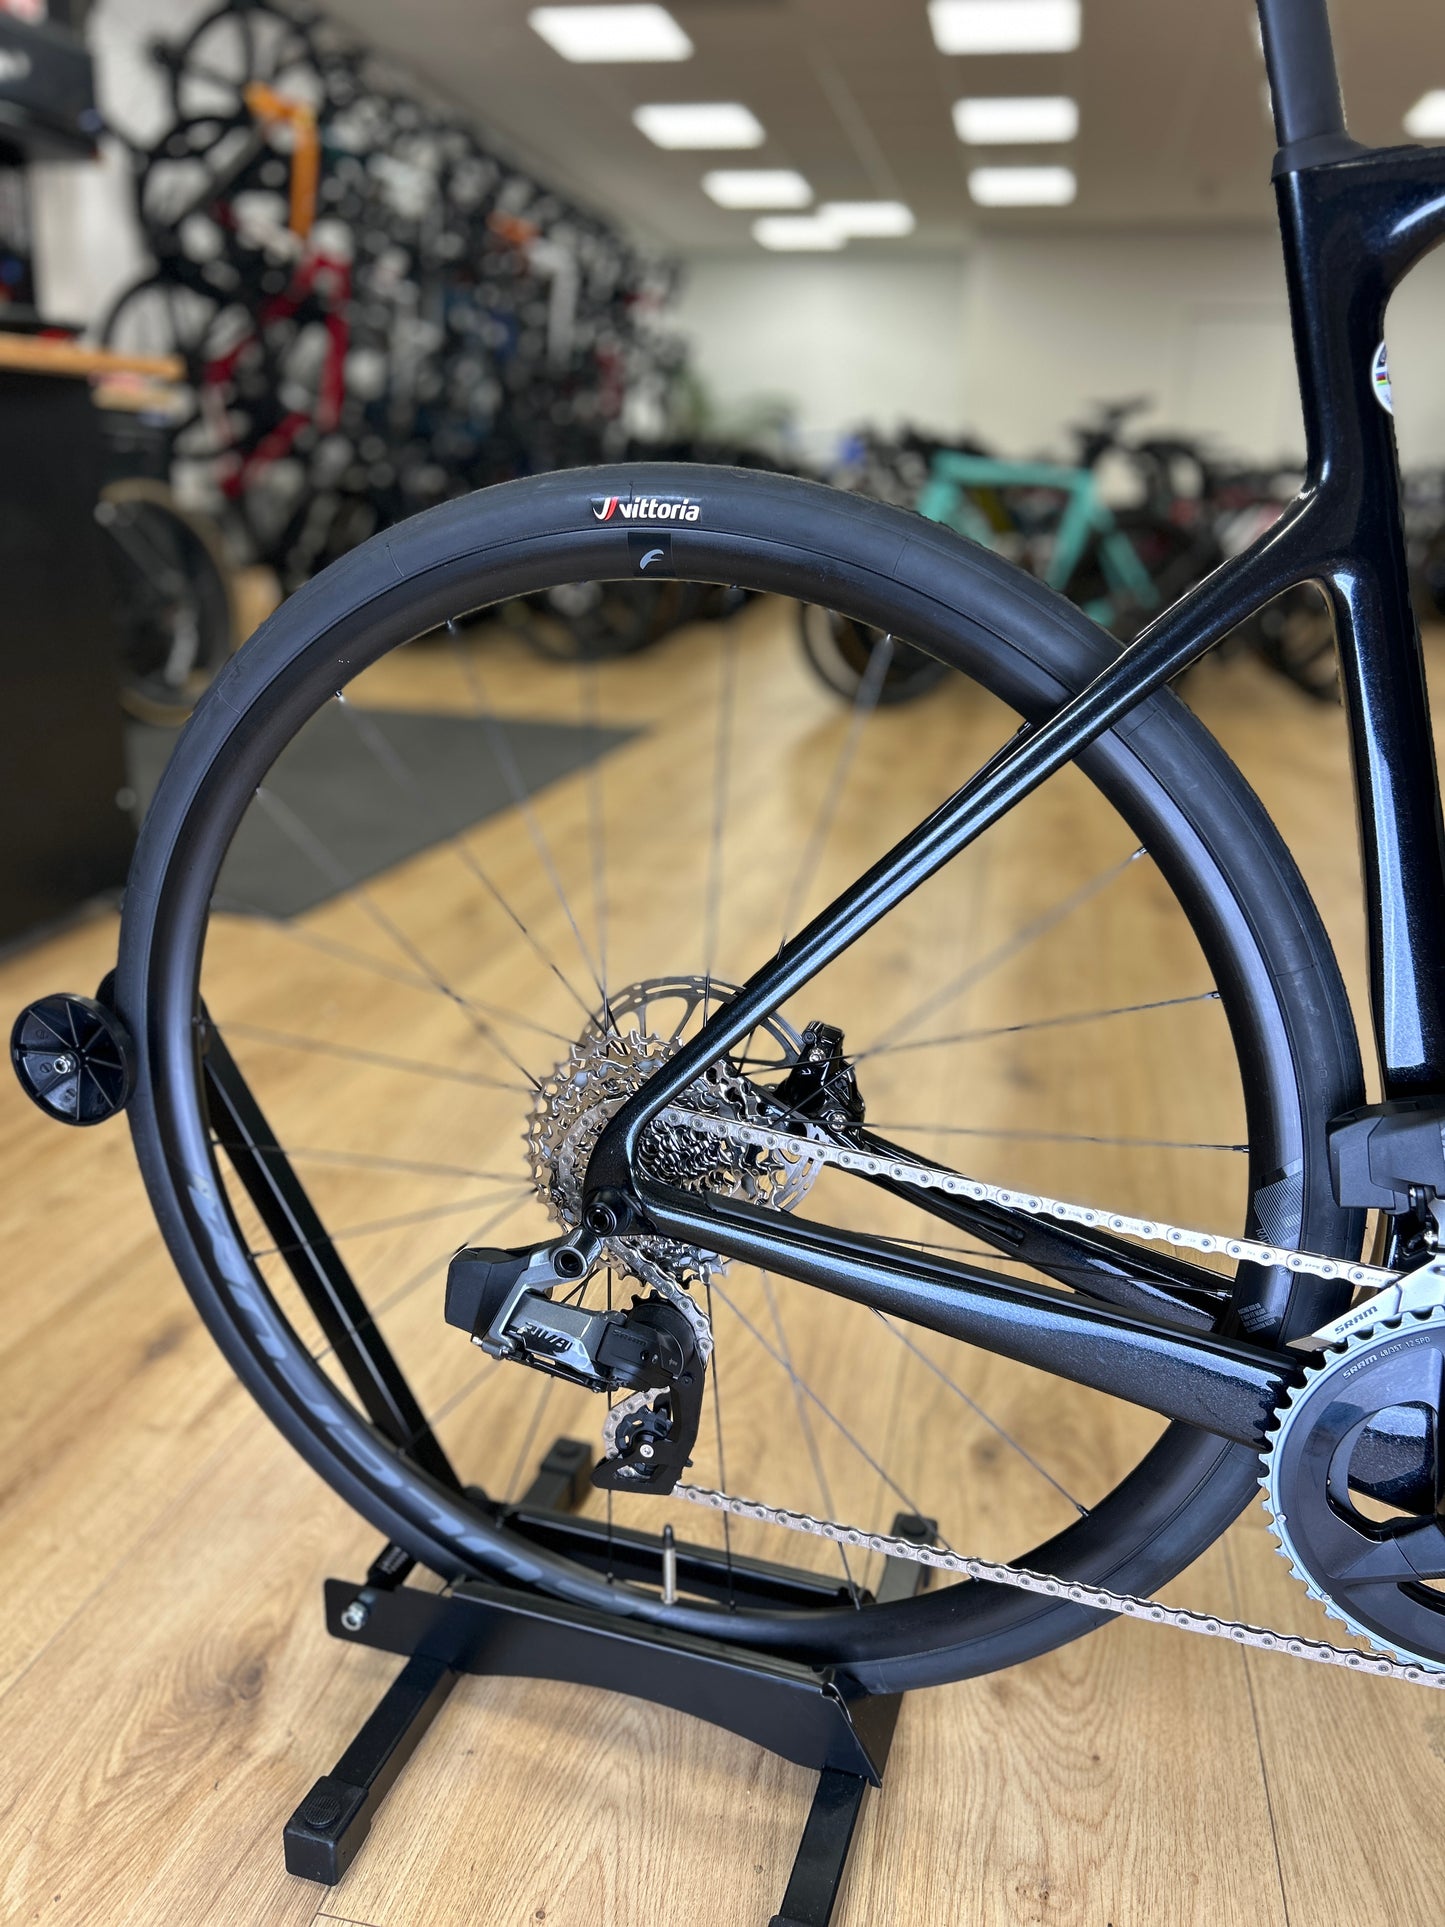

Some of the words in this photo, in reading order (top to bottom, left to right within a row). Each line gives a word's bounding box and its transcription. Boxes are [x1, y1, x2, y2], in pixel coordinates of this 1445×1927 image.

[619, 497, 700, 521] vittoria
[1334, 1305, 1378, 1335] SRAM
[1342, 1354, 1378, 1379] SRAM
[1380, 1343, 1402, 1359] 48/35T
[1405, 1340, 1414, 1349] 12
[1415, 1336, 1431, 1345] SPD
